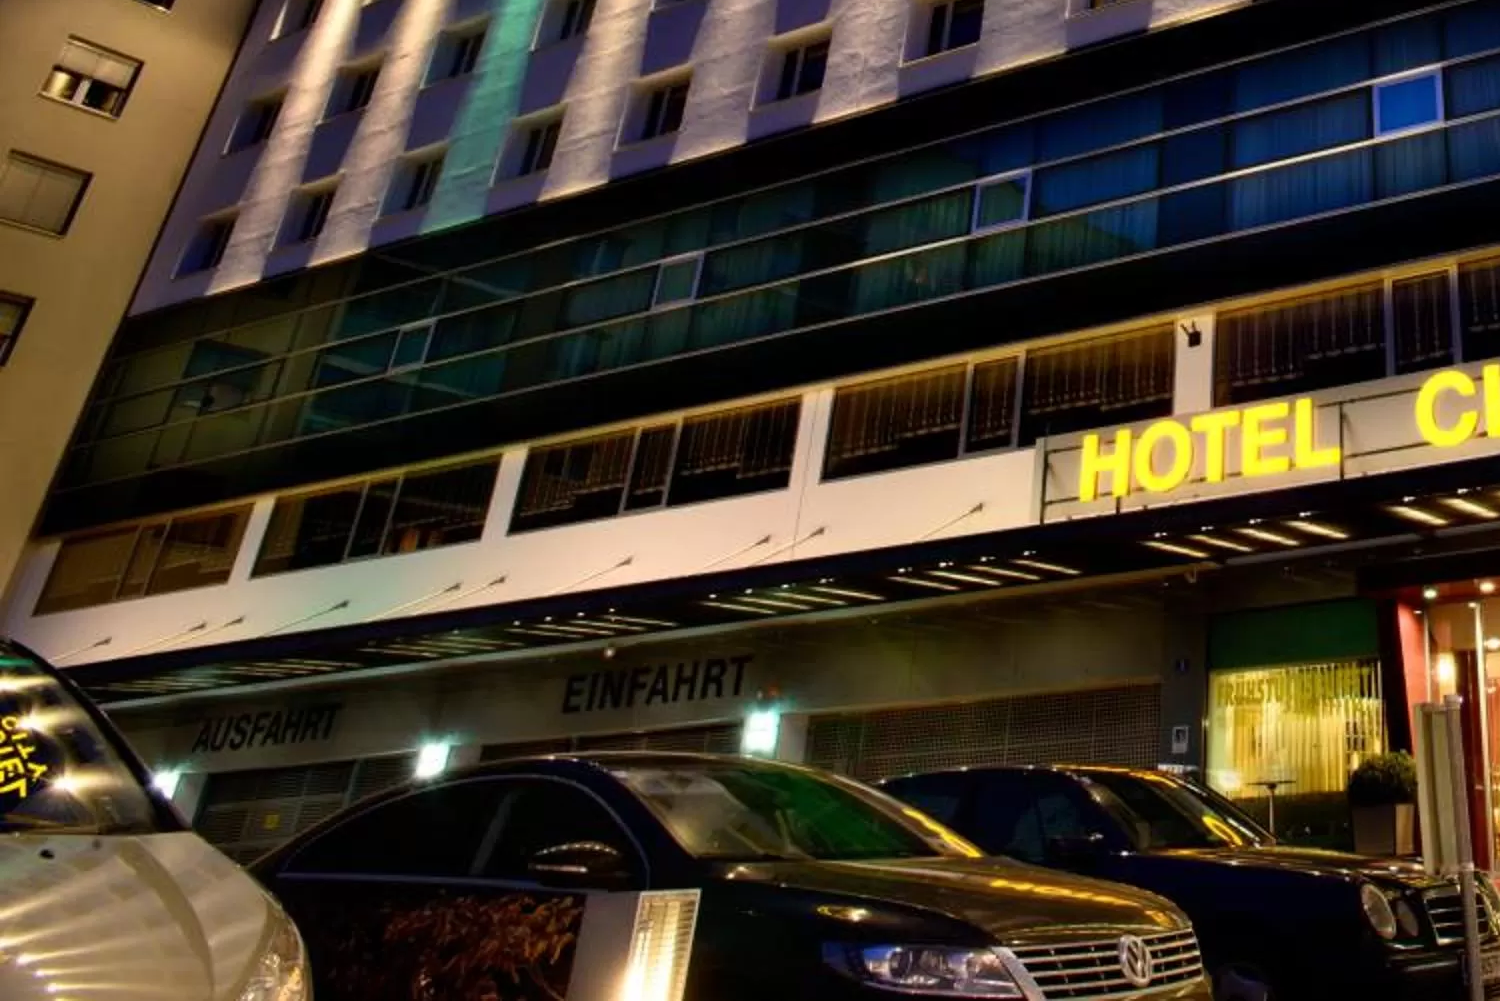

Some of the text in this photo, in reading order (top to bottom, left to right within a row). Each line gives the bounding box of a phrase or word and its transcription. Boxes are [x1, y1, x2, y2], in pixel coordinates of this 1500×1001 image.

[1078, 397, 1341, 503] HOTEL
[562, 655, 754, 714] EINFAHRT
[191, 702, 343, 753] AUSFAHRT
